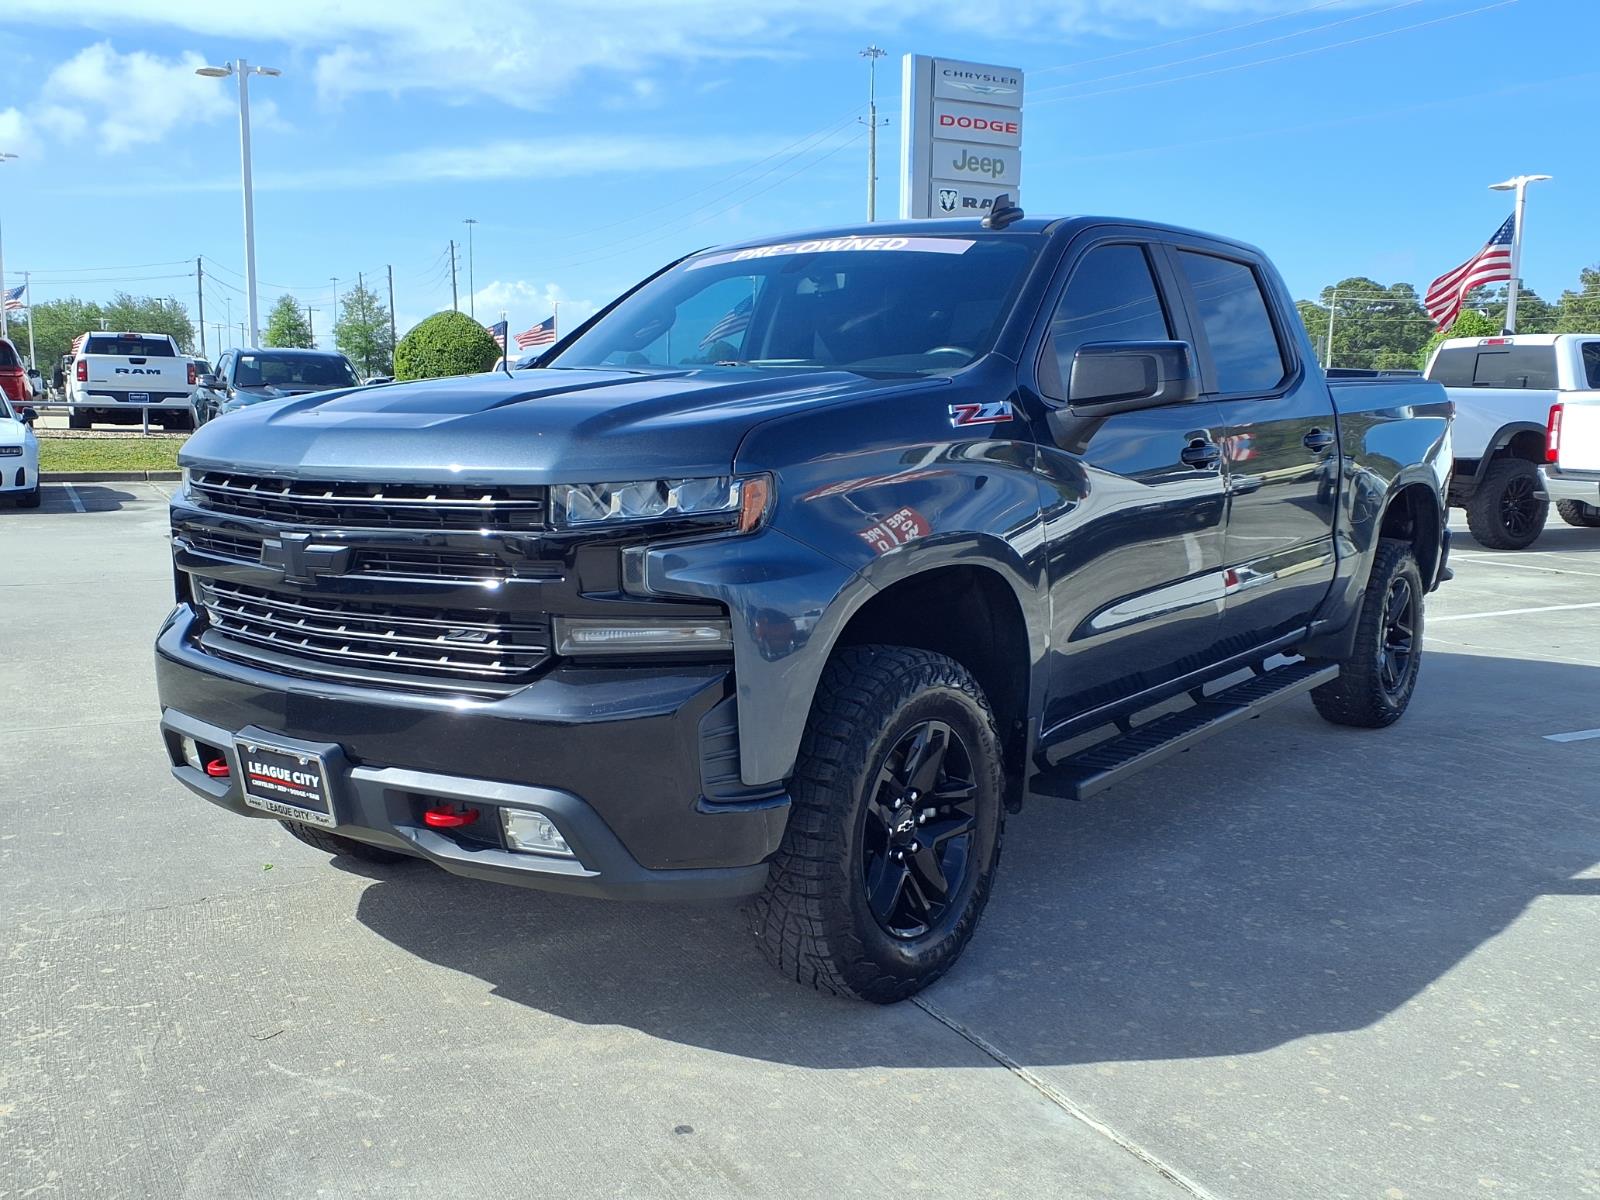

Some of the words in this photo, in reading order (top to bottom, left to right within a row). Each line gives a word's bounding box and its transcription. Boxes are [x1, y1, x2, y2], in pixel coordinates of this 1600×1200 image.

[943, 69, 1017, 85] CHRYSLER
[940, 114, 1018, 134] DODGE
[952, 149, 1005, 178] Jeep
[962, 196, 1015, 210] RA
[731, 237, 909, 262] PRE-OWNED
[248, 761, 291, 782] LEAGUE
[292, 771, 319, 788] CITY
[266, 802, 292, 816] LEAGUE
[293, 810, 309, 820] CITY
